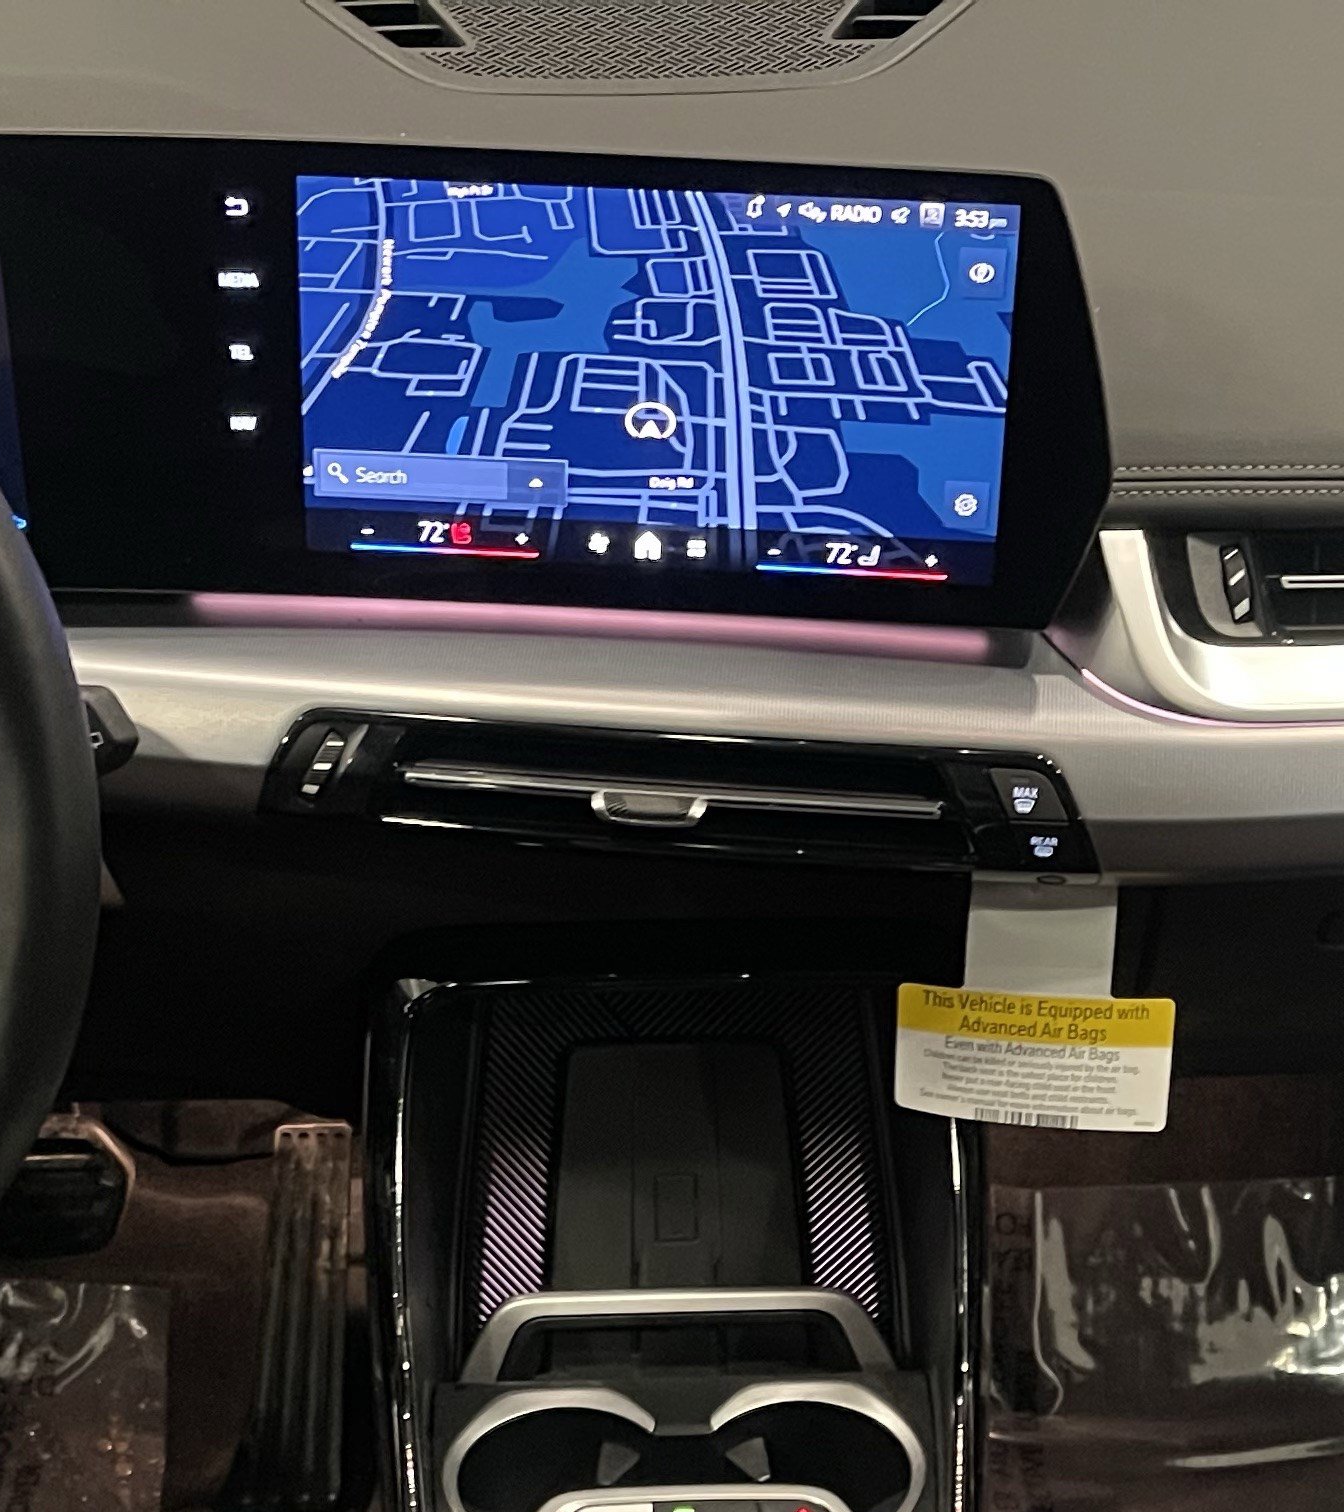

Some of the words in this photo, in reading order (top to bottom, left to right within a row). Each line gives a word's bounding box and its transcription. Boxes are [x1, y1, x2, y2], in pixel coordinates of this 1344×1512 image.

[830, 204, 883, 224] RADIO
[355, 466, 408, 484] Search
[1012, 786, 1039, 799] MAX
[922, 989, 955, 1009] This
[958, 993, 1016, 1015] Vehicle
[1020, 998, 1033, 1016] is
[1037, 1000, 1114, 1023] Equipped
[1116, 1003, 1150, 1020] with
[959, 1014, 1038, 1038] Advanced
[1039, 1022, 1064, 1039] Air
[1067, 1023, 1108, 1046] Bags
[944, 1035, 975, 1052] Even
[1004, 1042, 1067, 1060] Advanced
[1088, 1046, 1121, 1065] Bags
